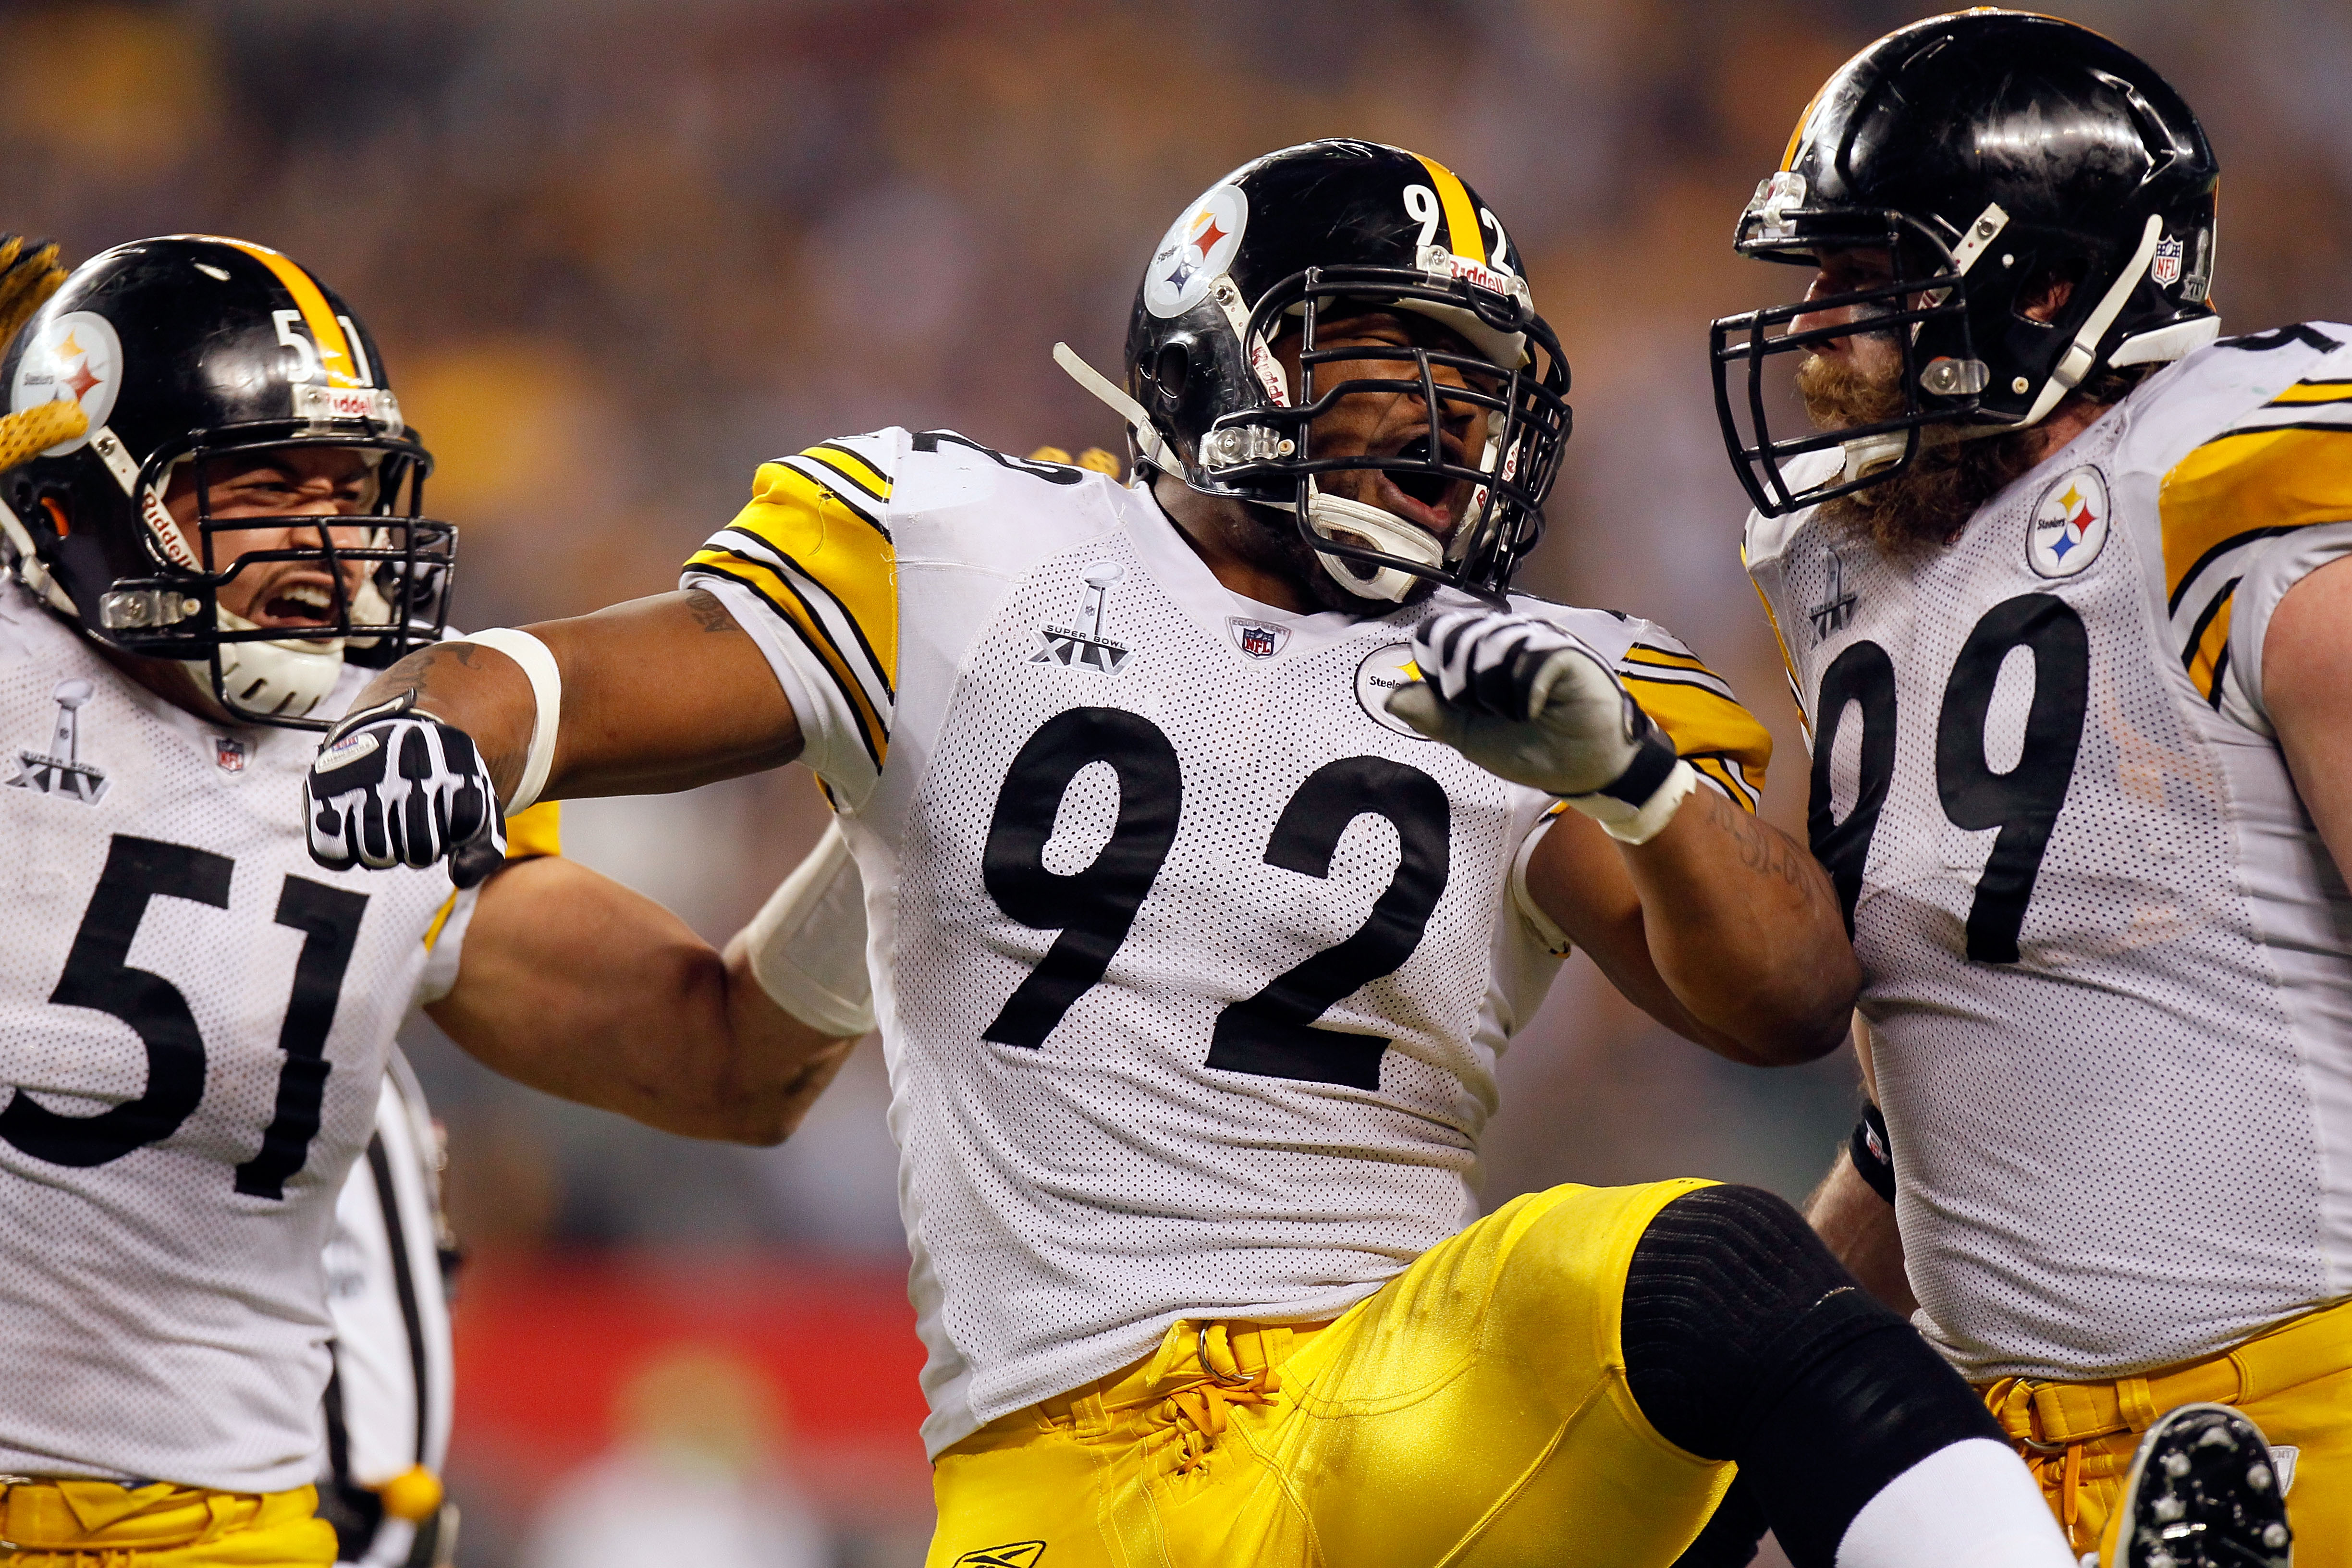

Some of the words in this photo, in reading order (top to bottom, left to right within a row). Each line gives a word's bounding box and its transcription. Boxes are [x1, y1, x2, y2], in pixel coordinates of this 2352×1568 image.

[1403, 184, 1514, 278] 92
[1449, 261, 1504, 294] Riddell
[2156, 258, 2177, 279] NFL
[272, 309, 374, 388] 51
[1252, 346, 1285, 407] Ridd
[142, 492, 191, 567] Riddell
[1027, 630, 1136, 676] XLV
[1046, 625, 1086, 639] SUPER
[1093, 635, 1127, 649] BOWL
[1245, 637, 1270, 653] NFL
[1369, 675, 1401, 689] Steele
[4, 757, 113, 807] XLV
[1808, 591, 2090, 963] 99
[981, 706, 1451, 1092] 92
[0, 833, 370, 1200] 51
